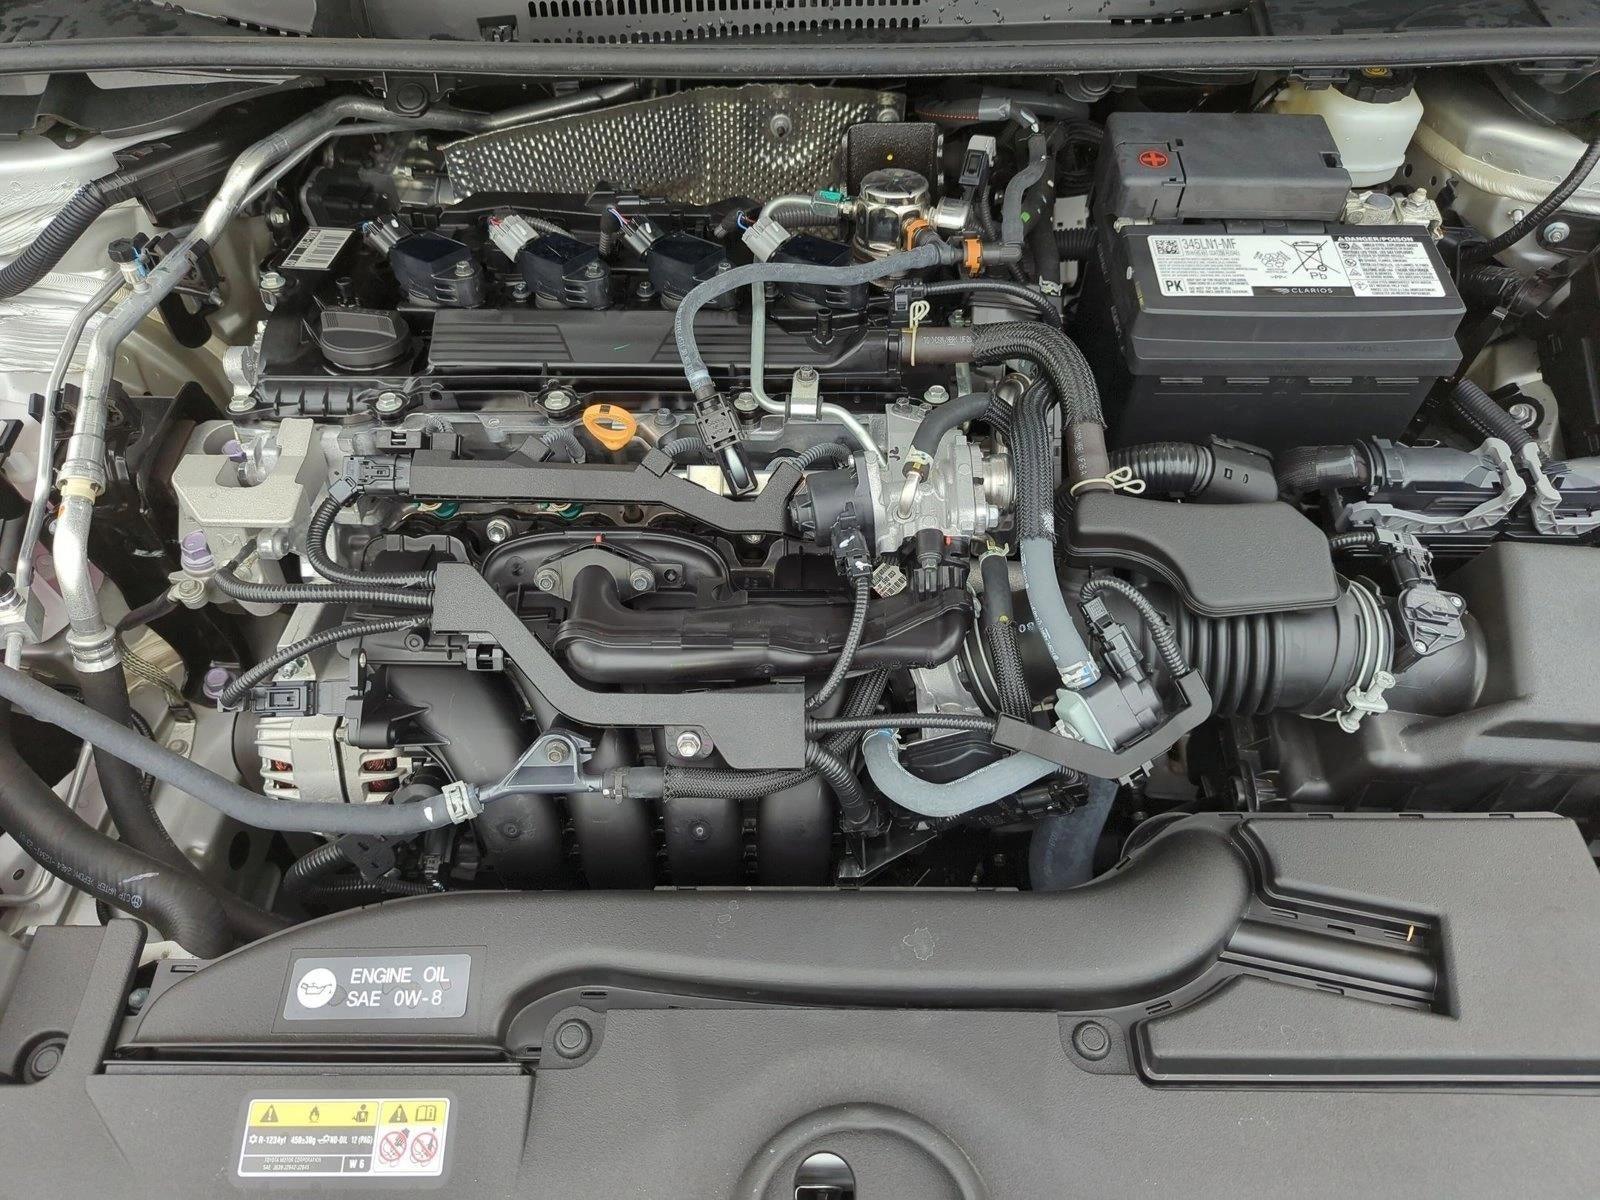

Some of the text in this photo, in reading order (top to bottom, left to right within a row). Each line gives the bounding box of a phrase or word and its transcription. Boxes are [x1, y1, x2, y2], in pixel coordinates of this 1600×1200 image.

[1182, 238, 1236, 250] 345LN1-MF
[1309, 271, 1328, 280] Pb
[1165, 280, 1184, 292] PK
[350, 966, 450, 984] ENGINE OIL
[346, 989, 442, 1007] SAE 0W-8
[349, 1159, 365, 1169] W 6
